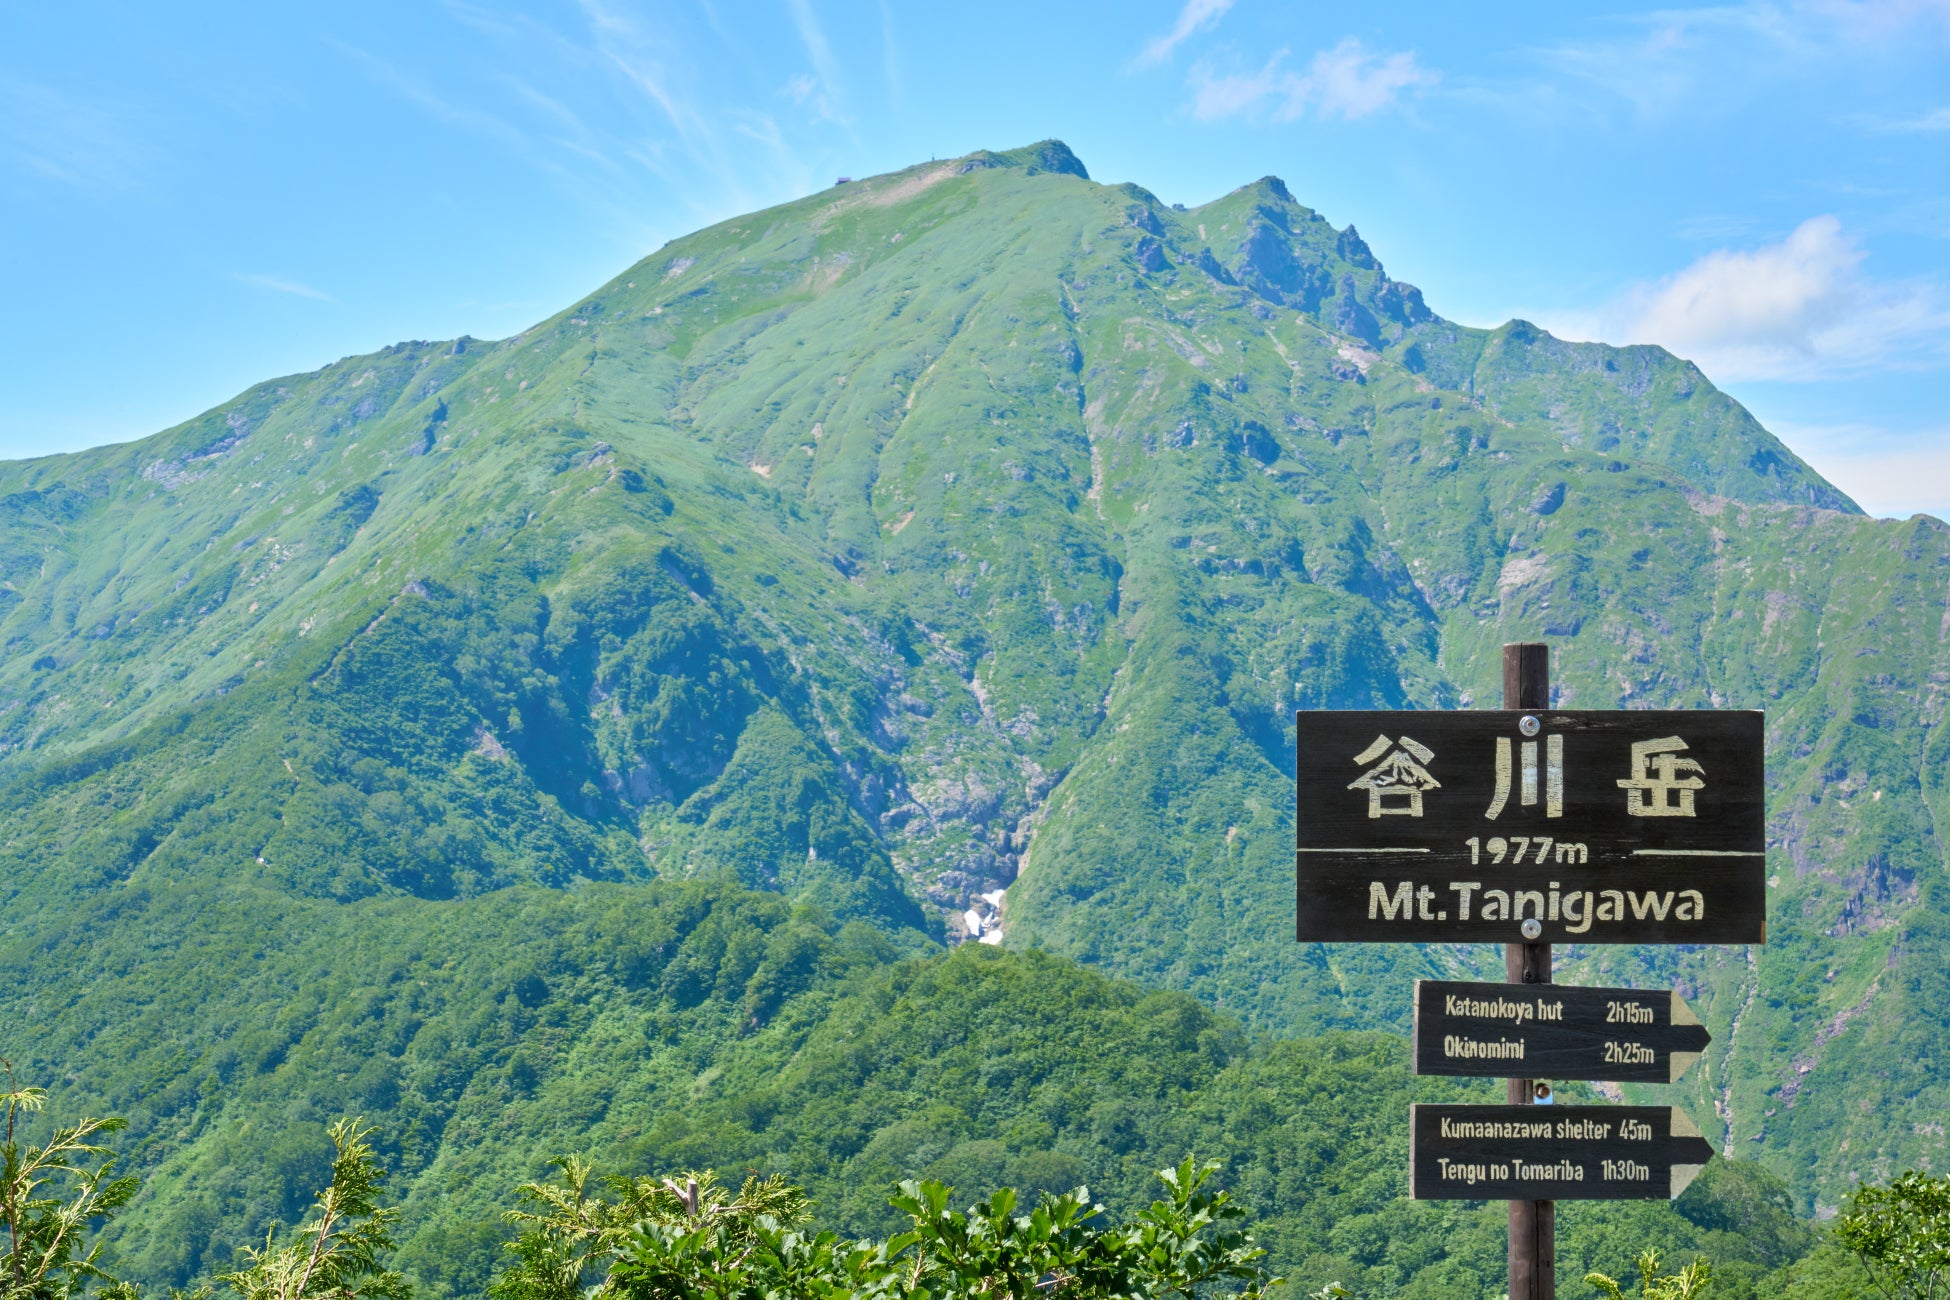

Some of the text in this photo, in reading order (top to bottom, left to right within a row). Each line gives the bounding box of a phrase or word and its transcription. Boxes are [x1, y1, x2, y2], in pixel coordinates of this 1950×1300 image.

[1347, 734, 1706, 820] 谷川岳
[1465, 837, 1588, 865] 1977m
[1368, 881, 1705, 933] Mt.Tanigawa
[1445, 995, 1654, 1025] Katanokoya hut 2h15m
[1444, 1035, 1655, 1064] Okinomimi 2h25m
[1441, 1117, 1652, 1140] Kumaanazawa shelter 45m
[1437, 1158, 1650, 1184] Tengu no Tomariba 1h30m
